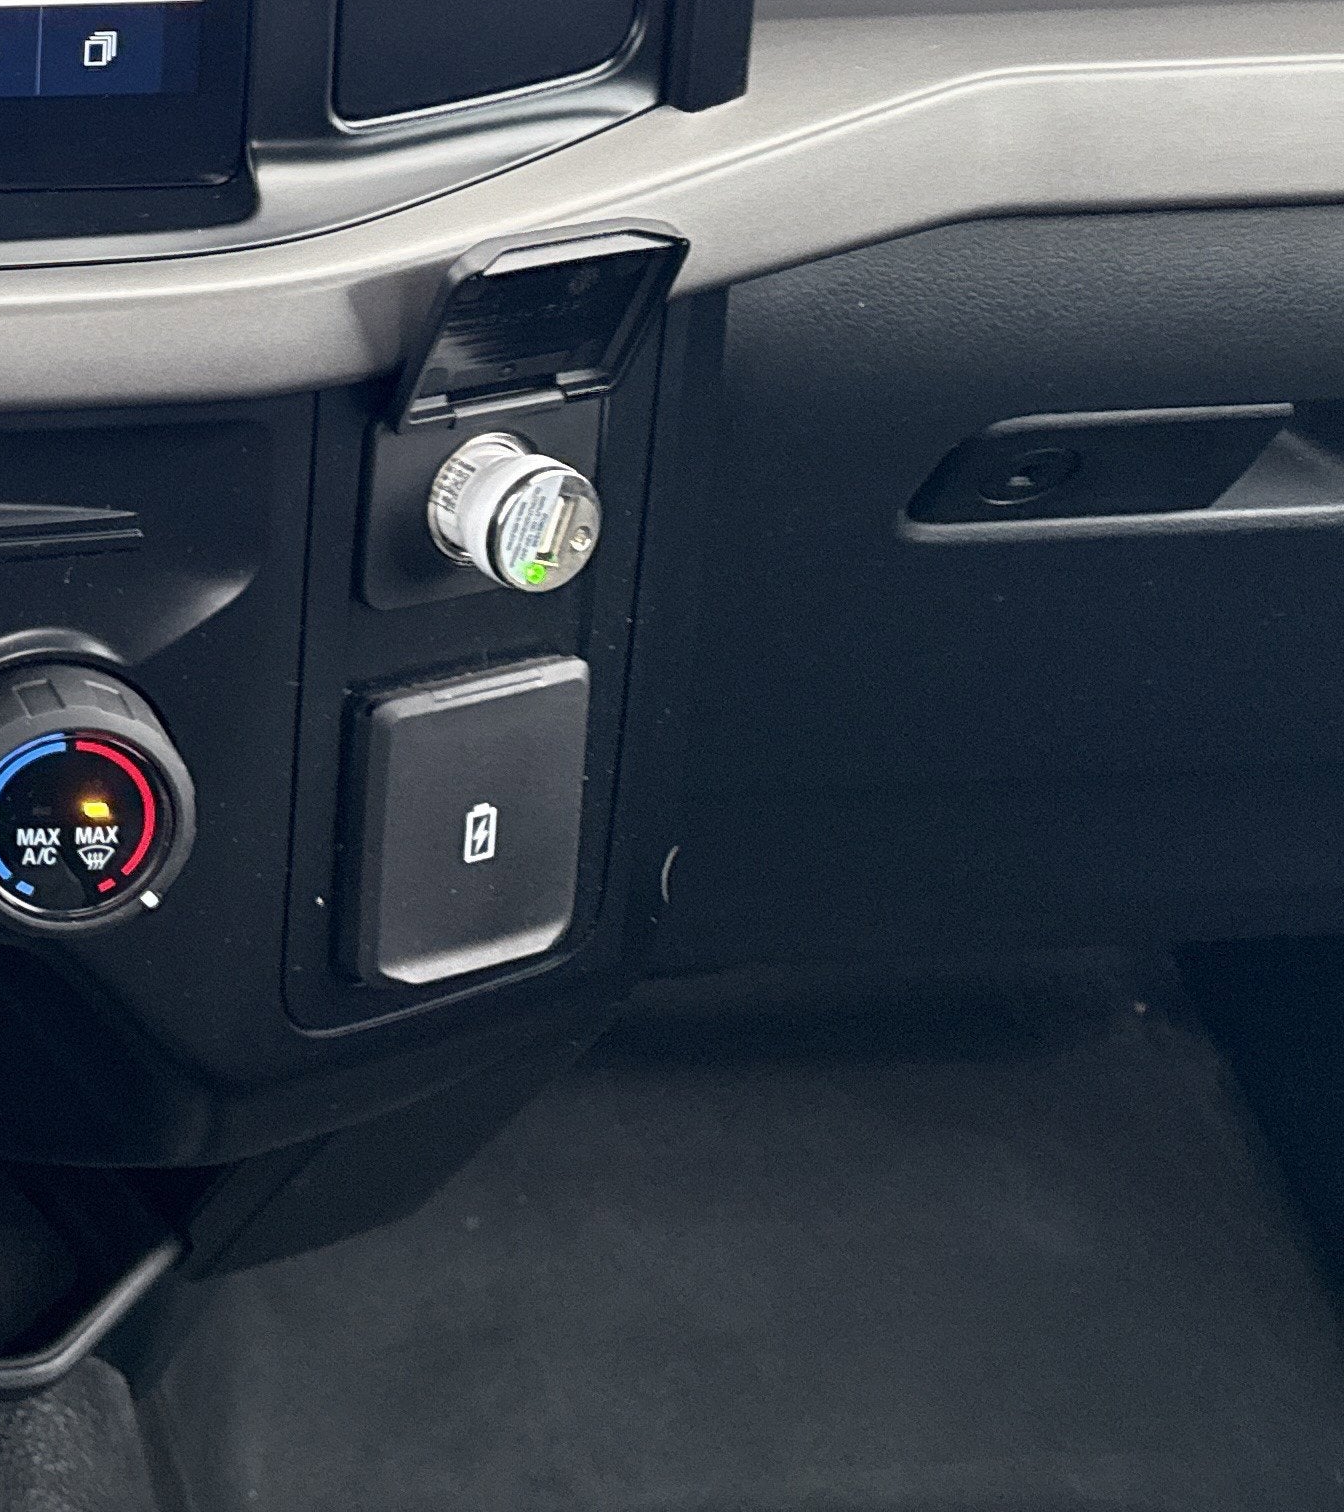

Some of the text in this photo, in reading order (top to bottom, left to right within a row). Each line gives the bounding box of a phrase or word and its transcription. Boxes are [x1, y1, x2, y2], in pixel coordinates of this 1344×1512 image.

[17, 828, 60, 846] MAX
[75, 826, 118, 845] MAX
[22, 847, 57, 865] A/C
